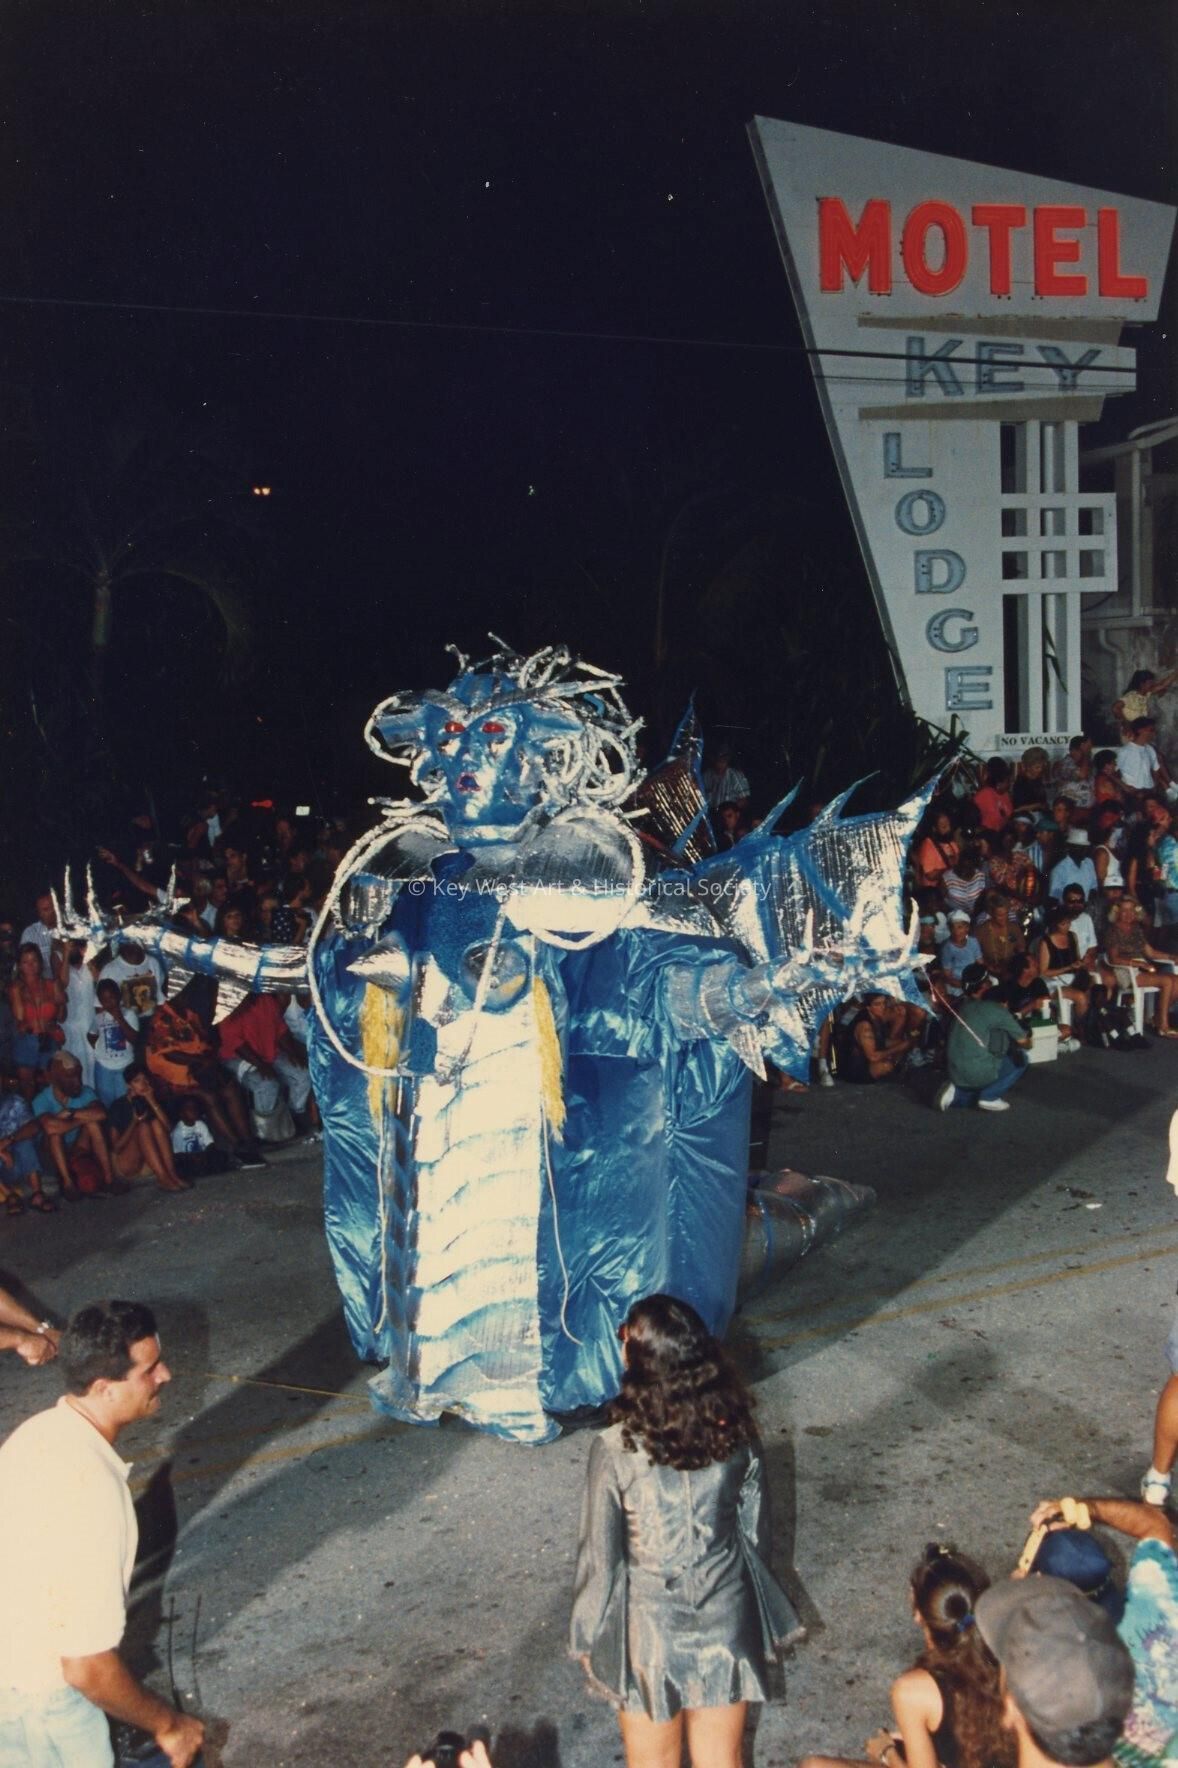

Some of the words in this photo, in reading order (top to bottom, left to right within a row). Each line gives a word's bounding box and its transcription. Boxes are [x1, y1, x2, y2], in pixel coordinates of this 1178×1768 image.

[818, 196, 1148, 298] MOTEL
[905, 335, 1101, 398] KEY
[883, 432, 993, 712] LODGE
[1001, 737, 1017, 746] NO
[1020, 735, 1070, 745] VACANCY
